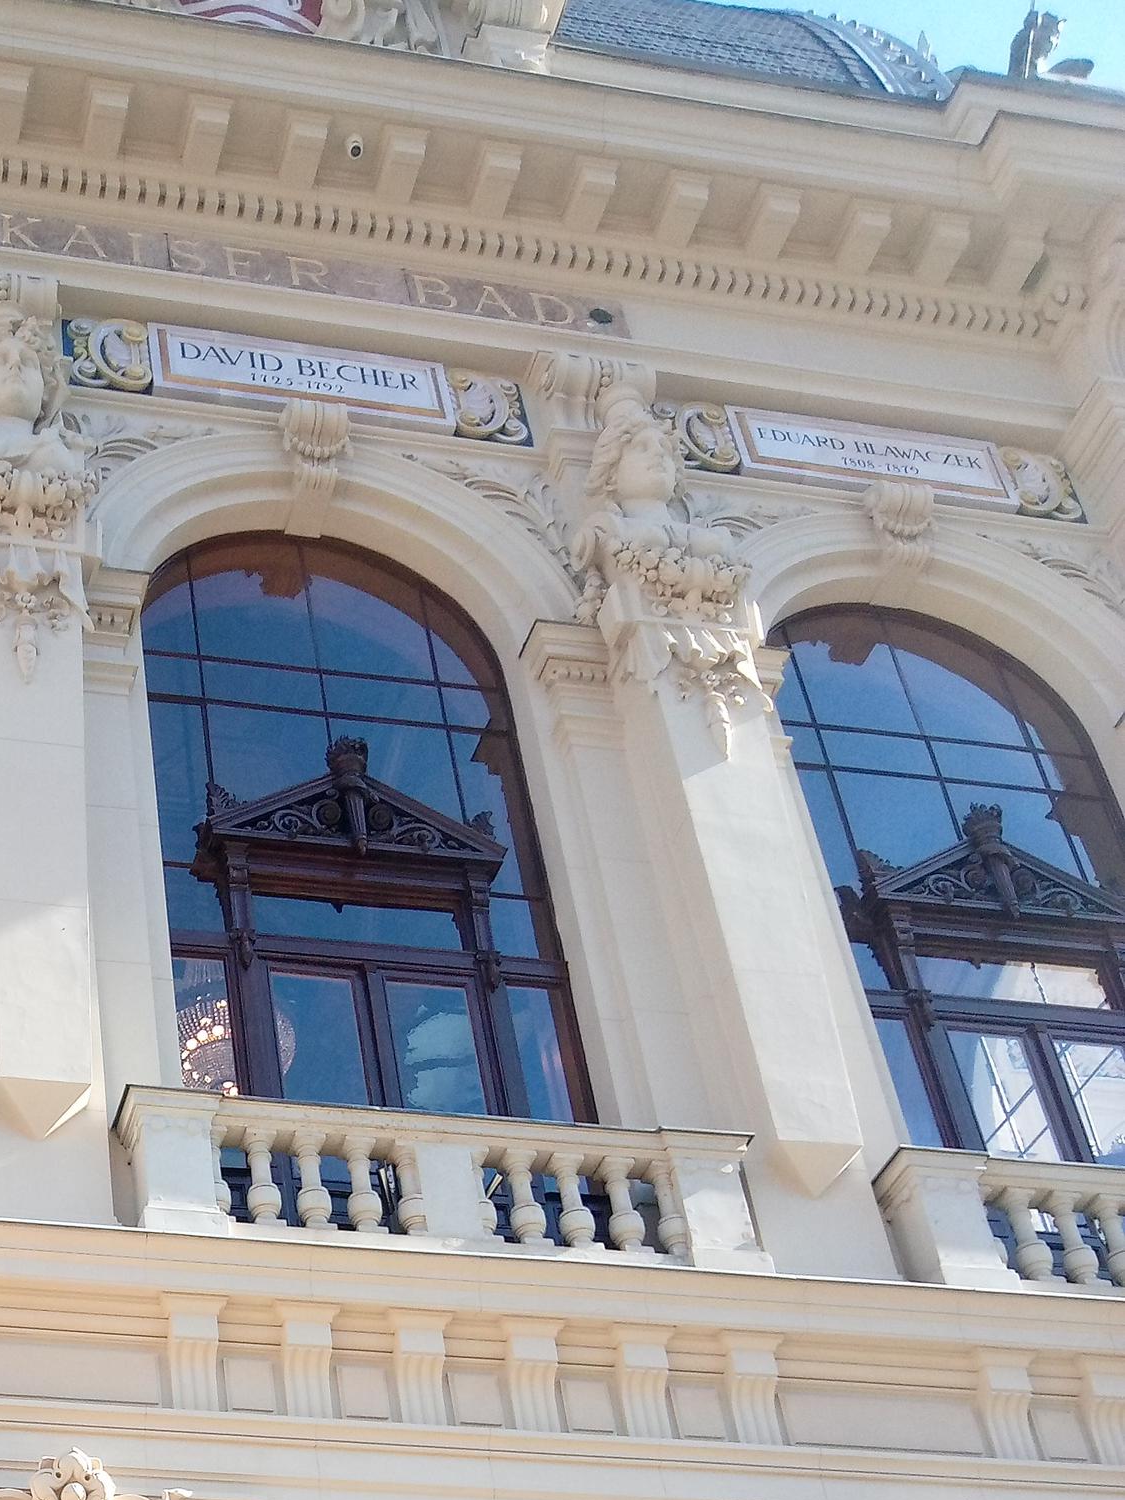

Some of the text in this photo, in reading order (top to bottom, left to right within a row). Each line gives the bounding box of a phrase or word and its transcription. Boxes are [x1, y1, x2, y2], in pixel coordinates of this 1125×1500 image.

[178, 341, 421, 391] DAVID BECHER
[757, 427, 983, 470] EDUARD HLAWACZEK
